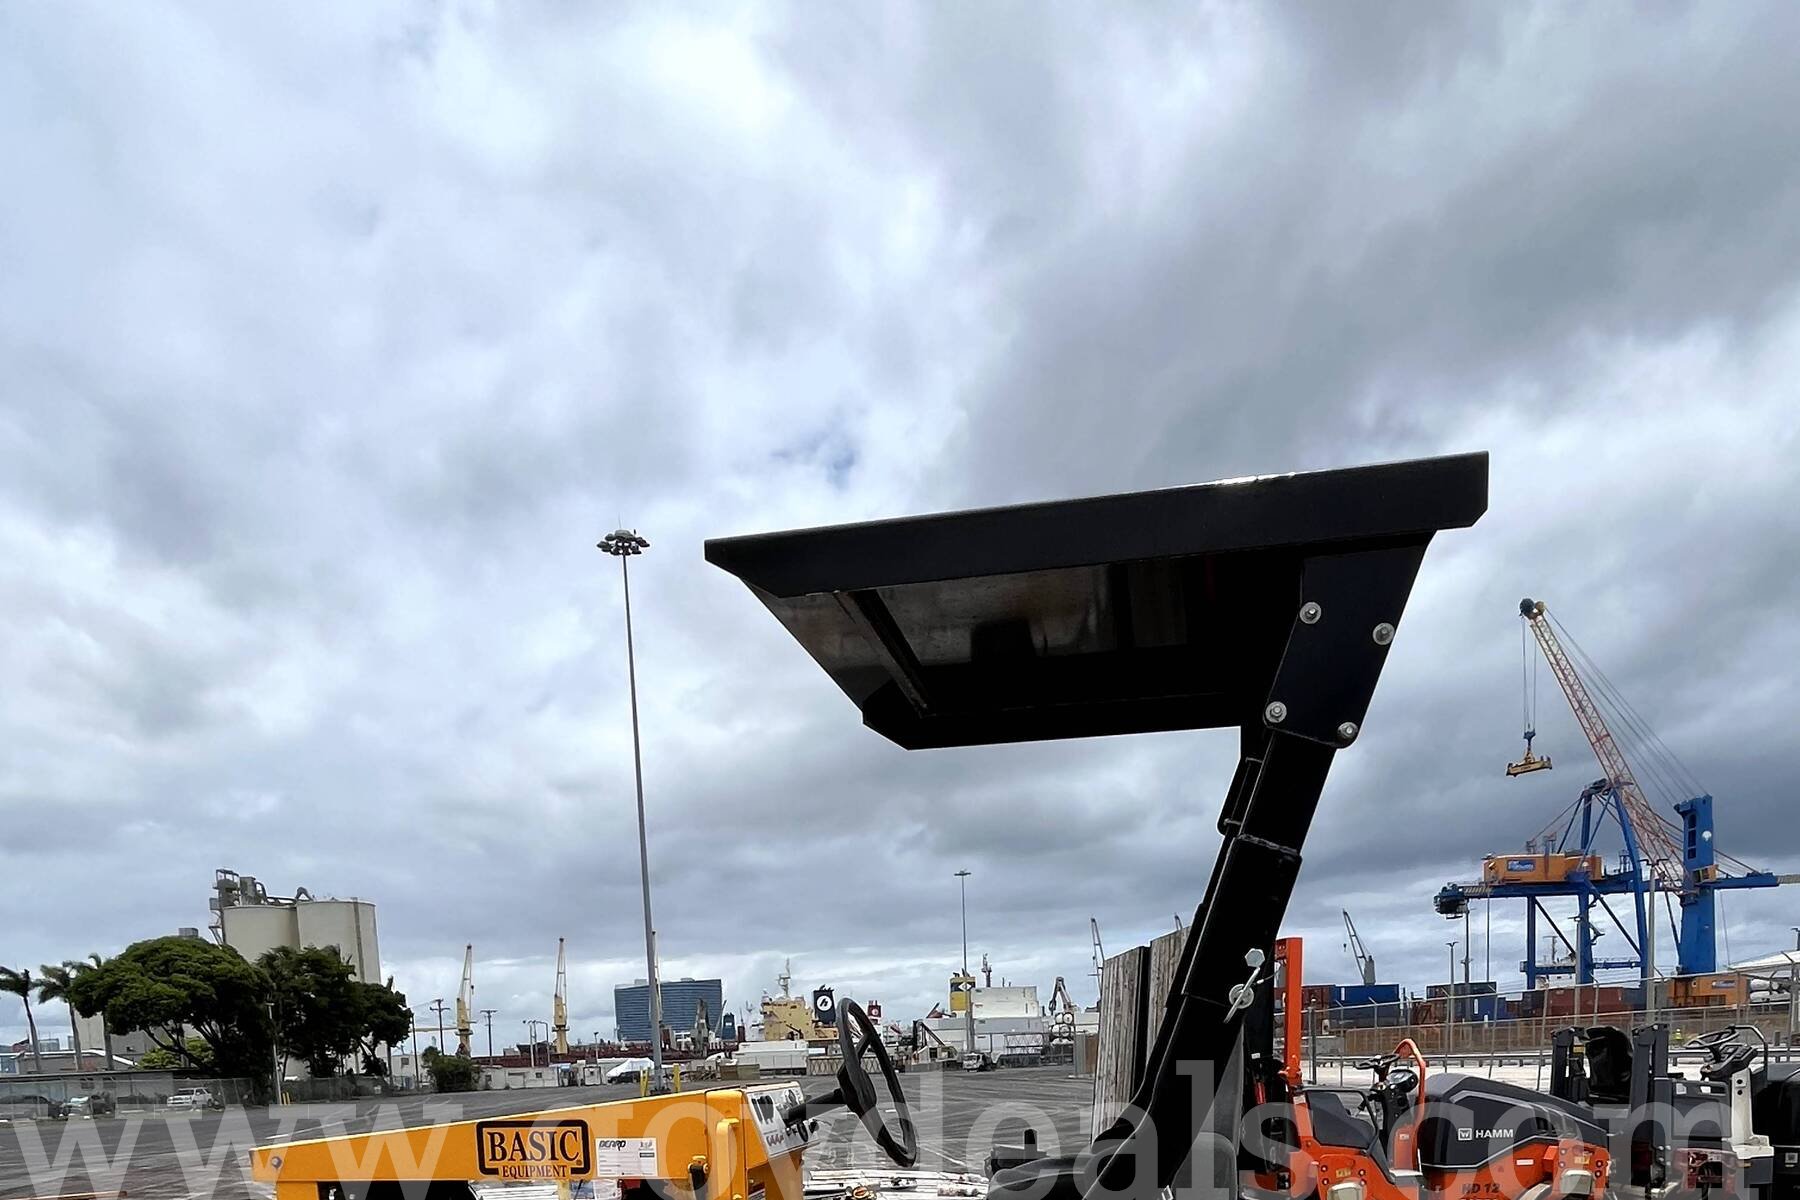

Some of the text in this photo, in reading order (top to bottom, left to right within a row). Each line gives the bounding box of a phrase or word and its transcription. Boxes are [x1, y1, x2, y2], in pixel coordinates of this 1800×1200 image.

[1475, 1129, 1514, 1138] HAMM
[487, 1130, 579, 1162] BASIC
[502, 1165, 568, 1177] EQUIPMENT
[1485, 1183, 1500, 1193] 12
